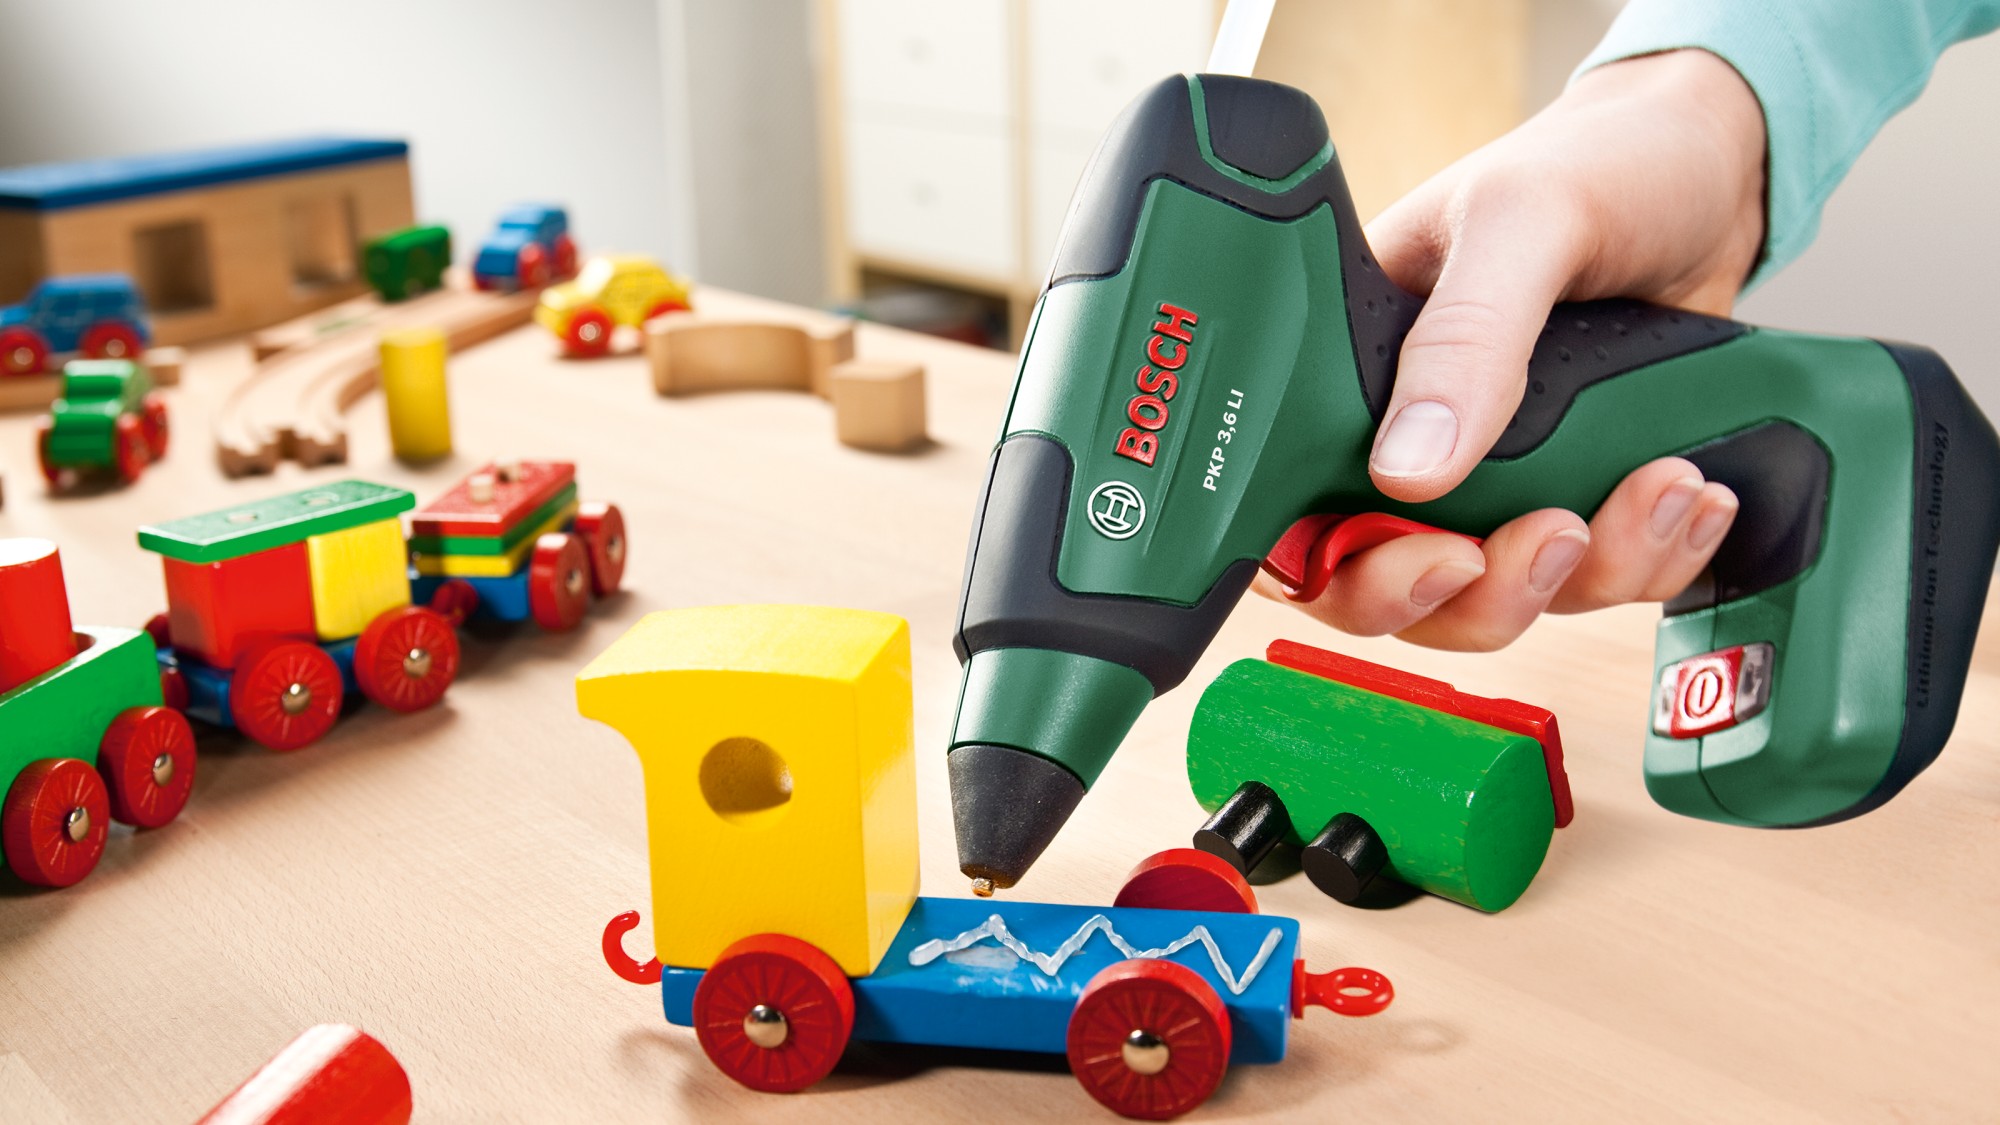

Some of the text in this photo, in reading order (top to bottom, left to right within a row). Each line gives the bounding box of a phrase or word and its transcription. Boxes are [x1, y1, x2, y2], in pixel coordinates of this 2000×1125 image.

[1115, 303, 1198, 467] BOSCH
[1203, 388, 1244, 491] PKP 3,6 LI
[1917, 422, 1948, 708] Lithium-Ion Technology
